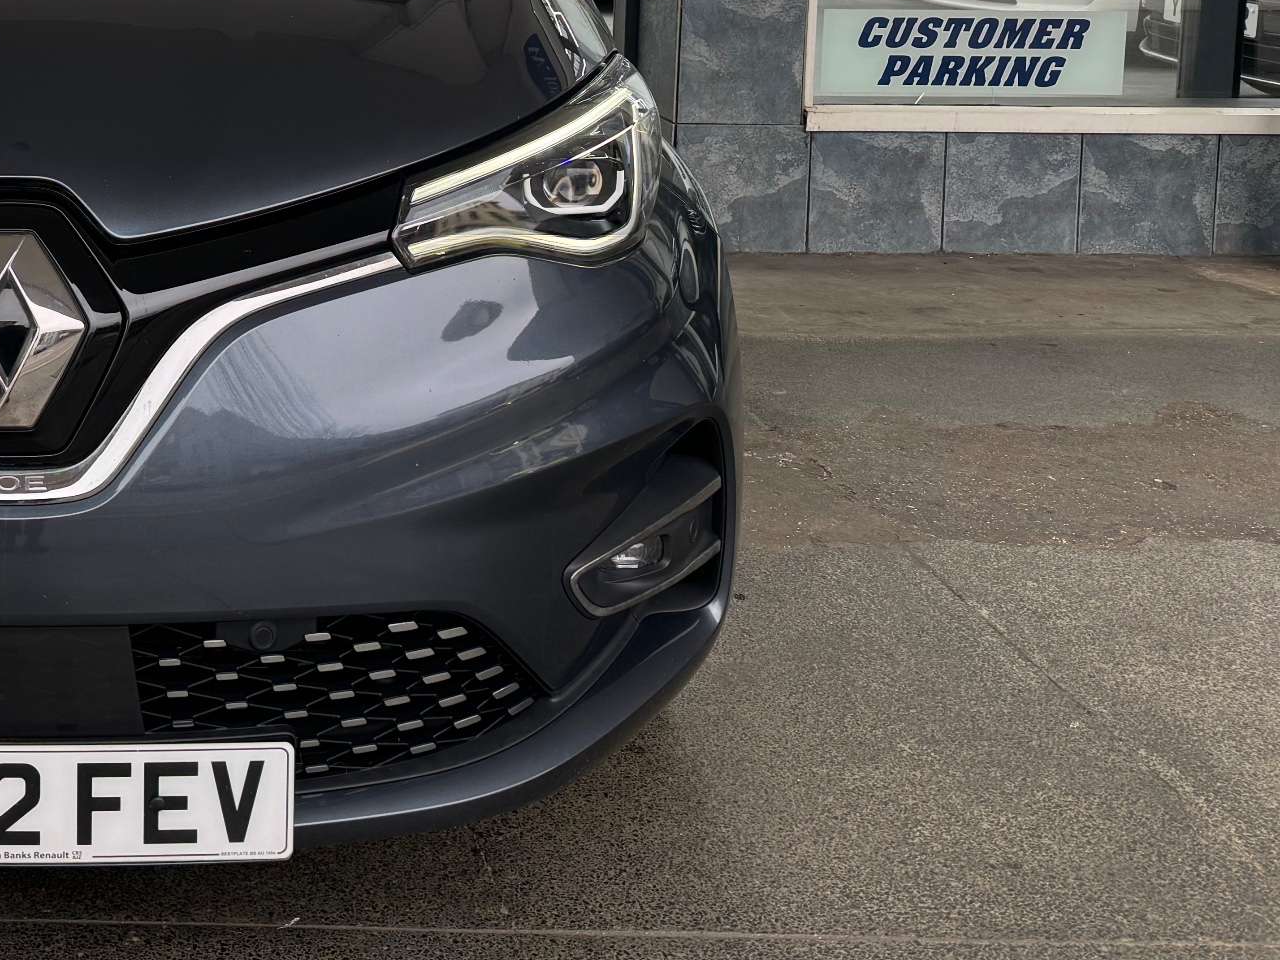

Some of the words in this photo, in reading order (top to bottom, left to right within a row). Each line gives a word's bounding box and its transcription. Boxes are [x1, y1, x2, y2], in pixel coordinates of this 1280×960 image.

[857, 16, 1091, 49] CUSTOMER
[877, 54, 1067, 88] PARKING
[76, 760, 266, 846] FEV
[4, 851, 31, 859] Banks
[33, 851, 69, 859] Renault
